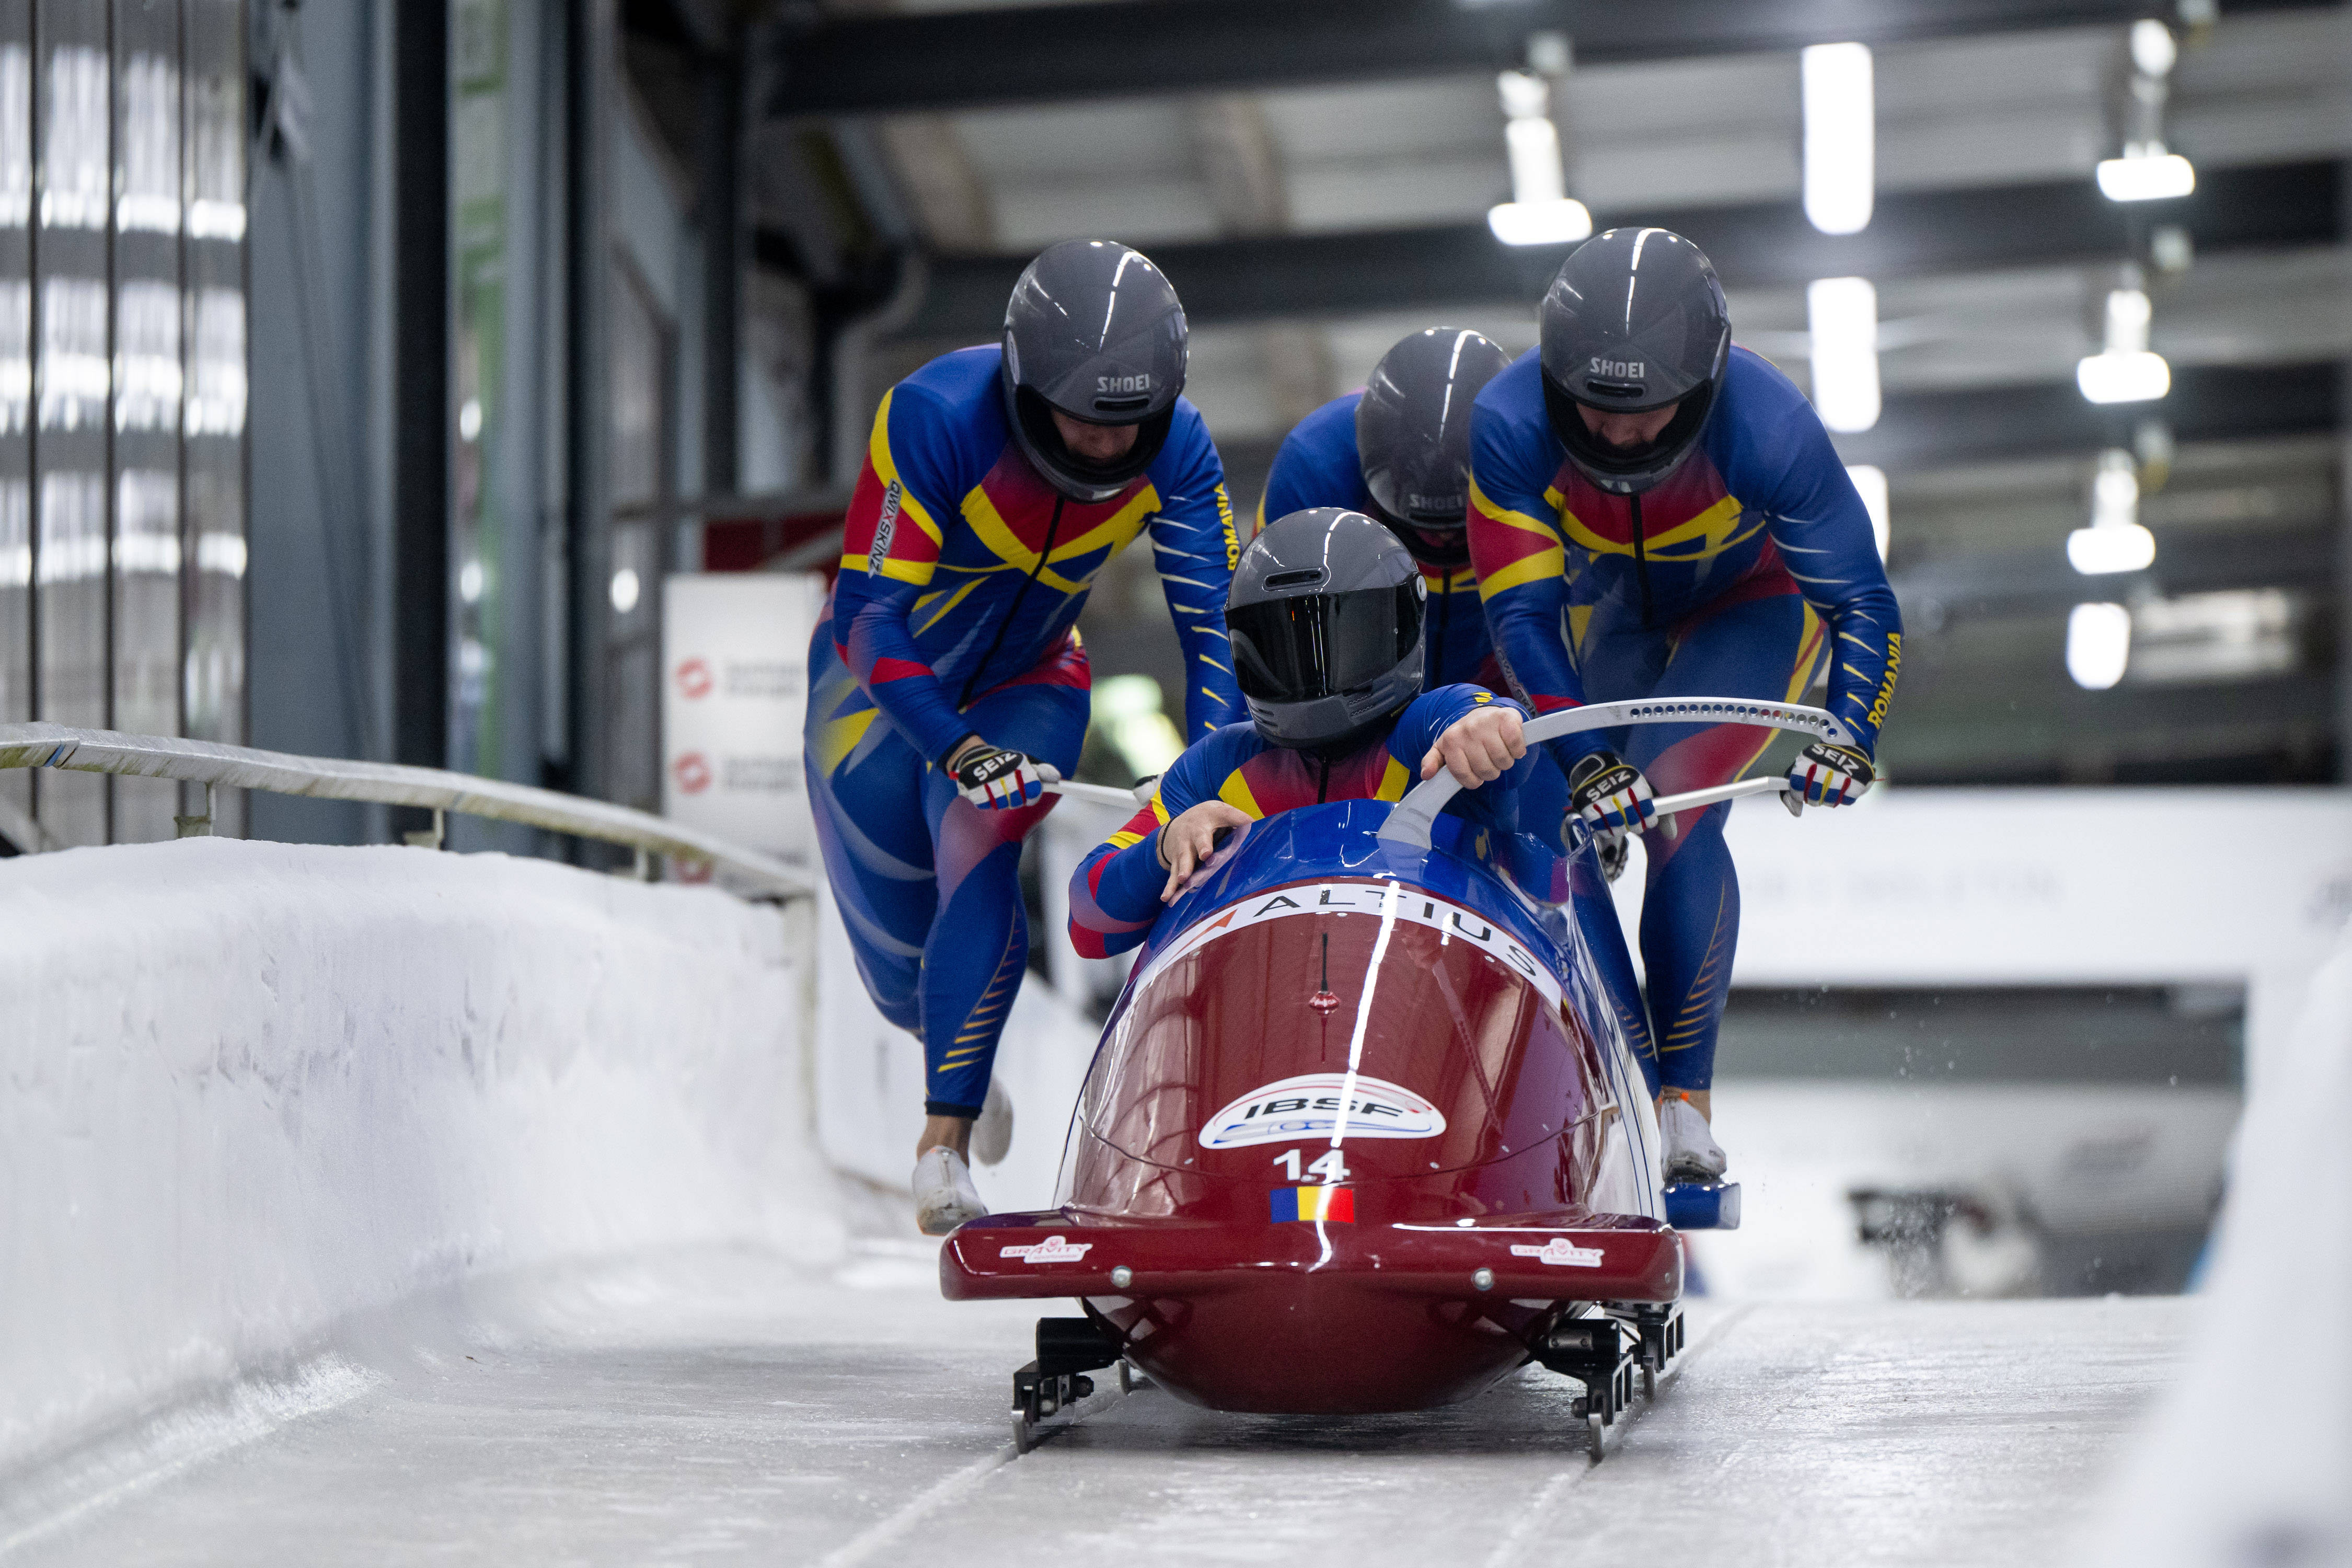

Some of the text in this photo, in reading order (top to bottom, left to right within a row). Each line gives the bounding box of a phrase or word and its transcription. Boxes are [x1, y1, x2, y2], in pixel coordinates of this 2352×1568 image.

[1589, 357, 1644, 378] SHOEI
[1097, 373, 1150, 393] SHOEI
[1409, 493, 1463, 510] SHOEI
[870, 480, 900, 573] QWIXSKINZ
[1867, 633, 1901, 730] ROMANIA
[973, 752, 1017, 782] SEIZ
[1811, 743, 1860, 777] SEIZ
[1586, 770, 1631, 802] SEIZ
[1253, 887, 1536, 977] ALTIUS
[1244, 1098, 1403, 1120] IBSF
[1273, 1149, 1351, 1182] 14
[1004, 1246, 1086, 1258] GRAVITY
[1515, 1247, 1599, 1259] GRAVITY
